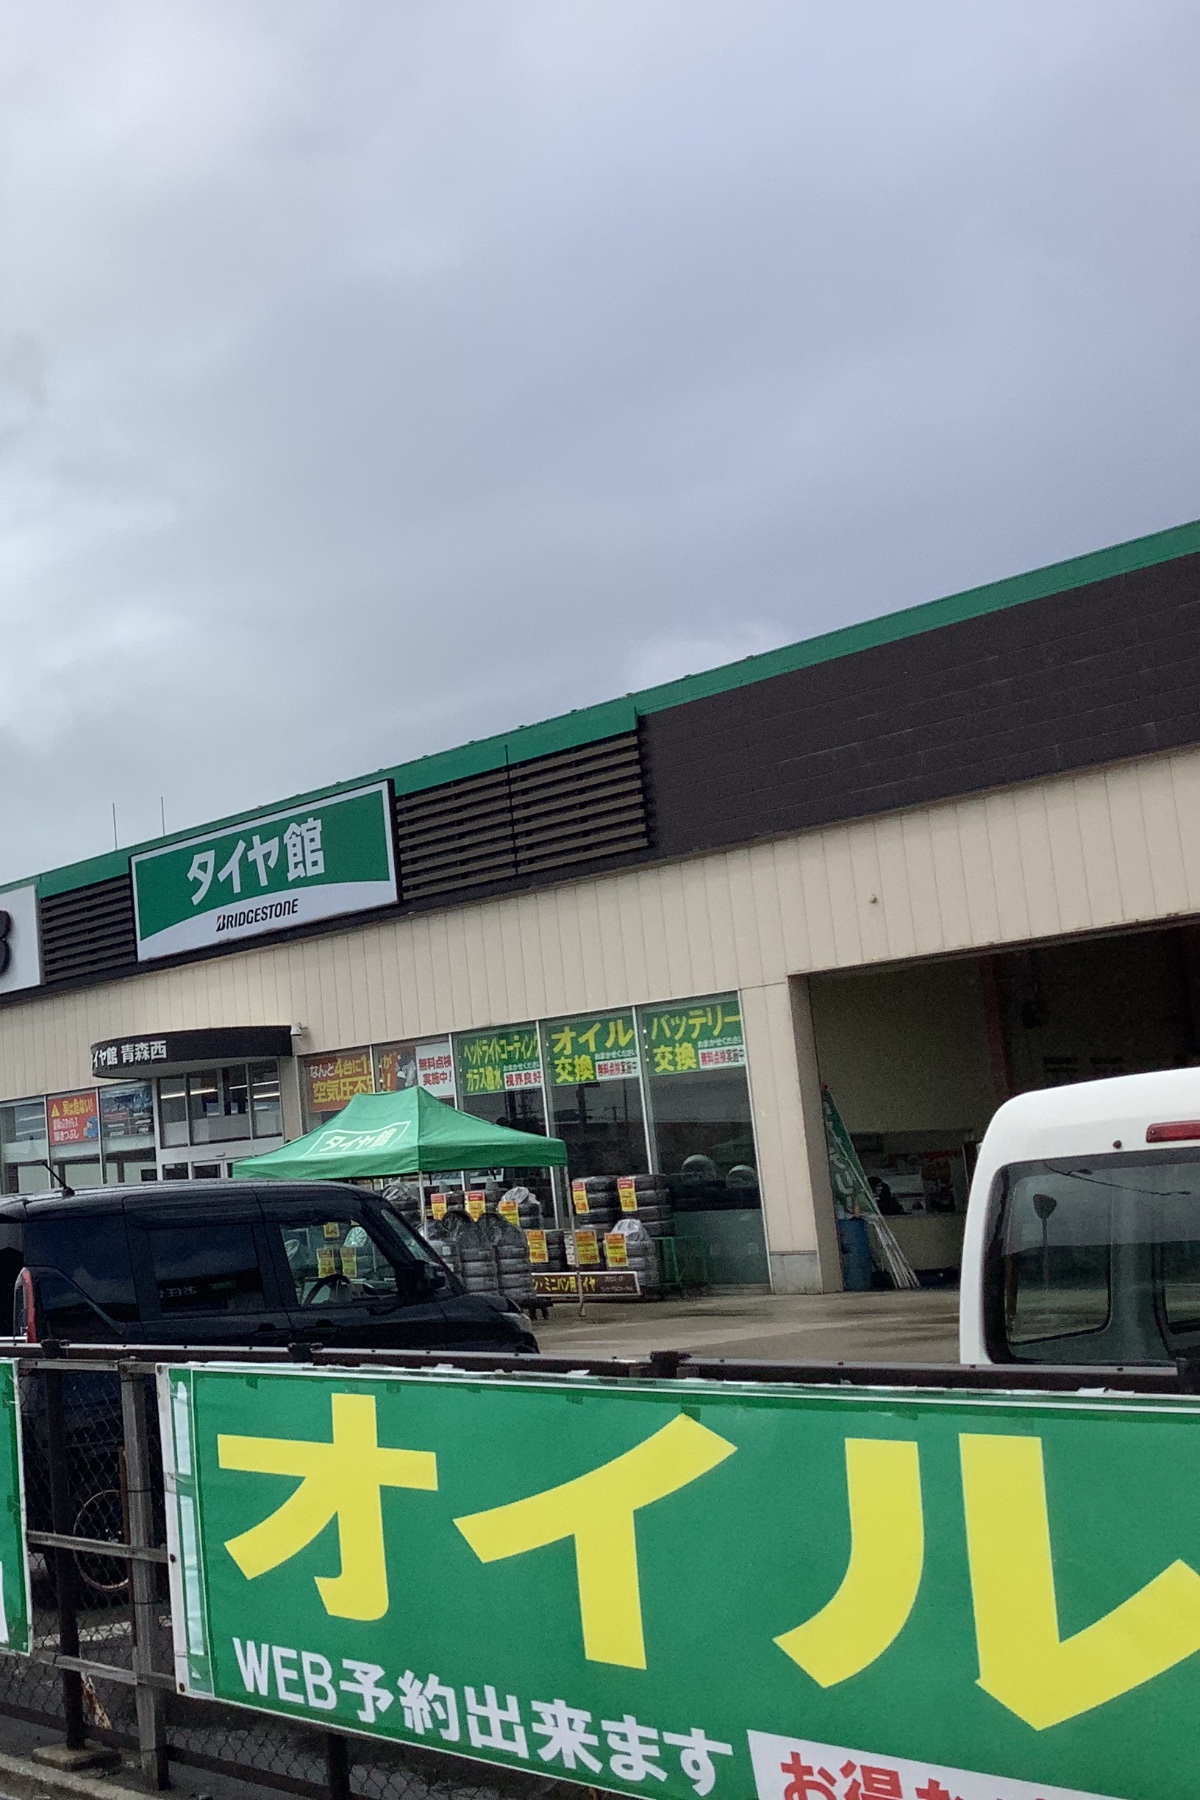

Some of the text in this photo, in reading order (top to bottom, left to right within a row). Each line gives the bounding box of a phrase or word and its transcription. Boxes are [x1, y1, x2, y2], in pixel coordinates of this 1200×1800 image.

[186, 817, 326, 907] タイヤ館
[215, 898, 300, 933] BRIDGESTONE
[551, 1019, 634, 1056] オイル
[651, 1005, 741, 1041] バッテリー
[92, 1040, 167, 1068] イヤ館 青森西
[309, 1054, 392, 1079] なんと4台に1が
[418, 1053, 451, 1071] 無料点検
[553, 1054, 595, 1084] 交換
[653, 1042, 697, 1073] 交換
[505, 1070, 542, 1089] 視界良好
[320, 1127, 397, 1153] タイヤ館
[217, 1393, 1200, 1731] オイル
[232, 1637, 733, 1797] WEB予約出来ます
